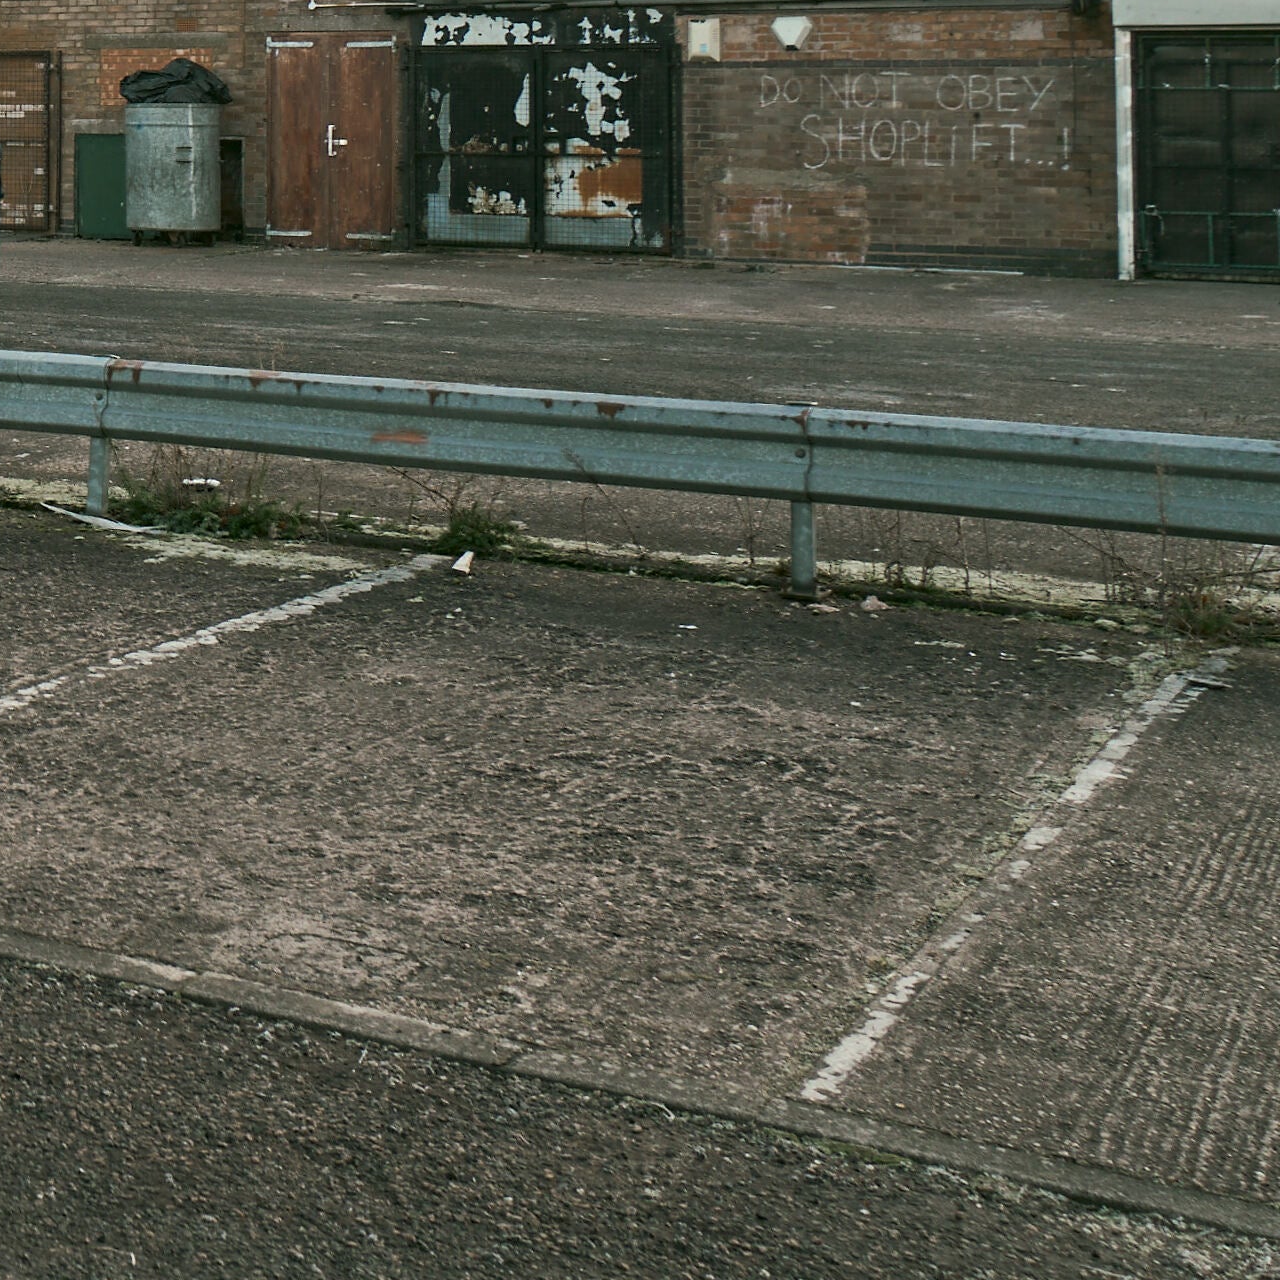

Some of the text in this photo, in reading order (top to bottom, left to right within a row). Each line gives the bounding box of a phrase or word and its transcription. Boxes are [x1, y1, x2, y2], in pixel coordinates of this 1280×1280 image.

[760, 71, 1056, 112] DO NOT OBEY
